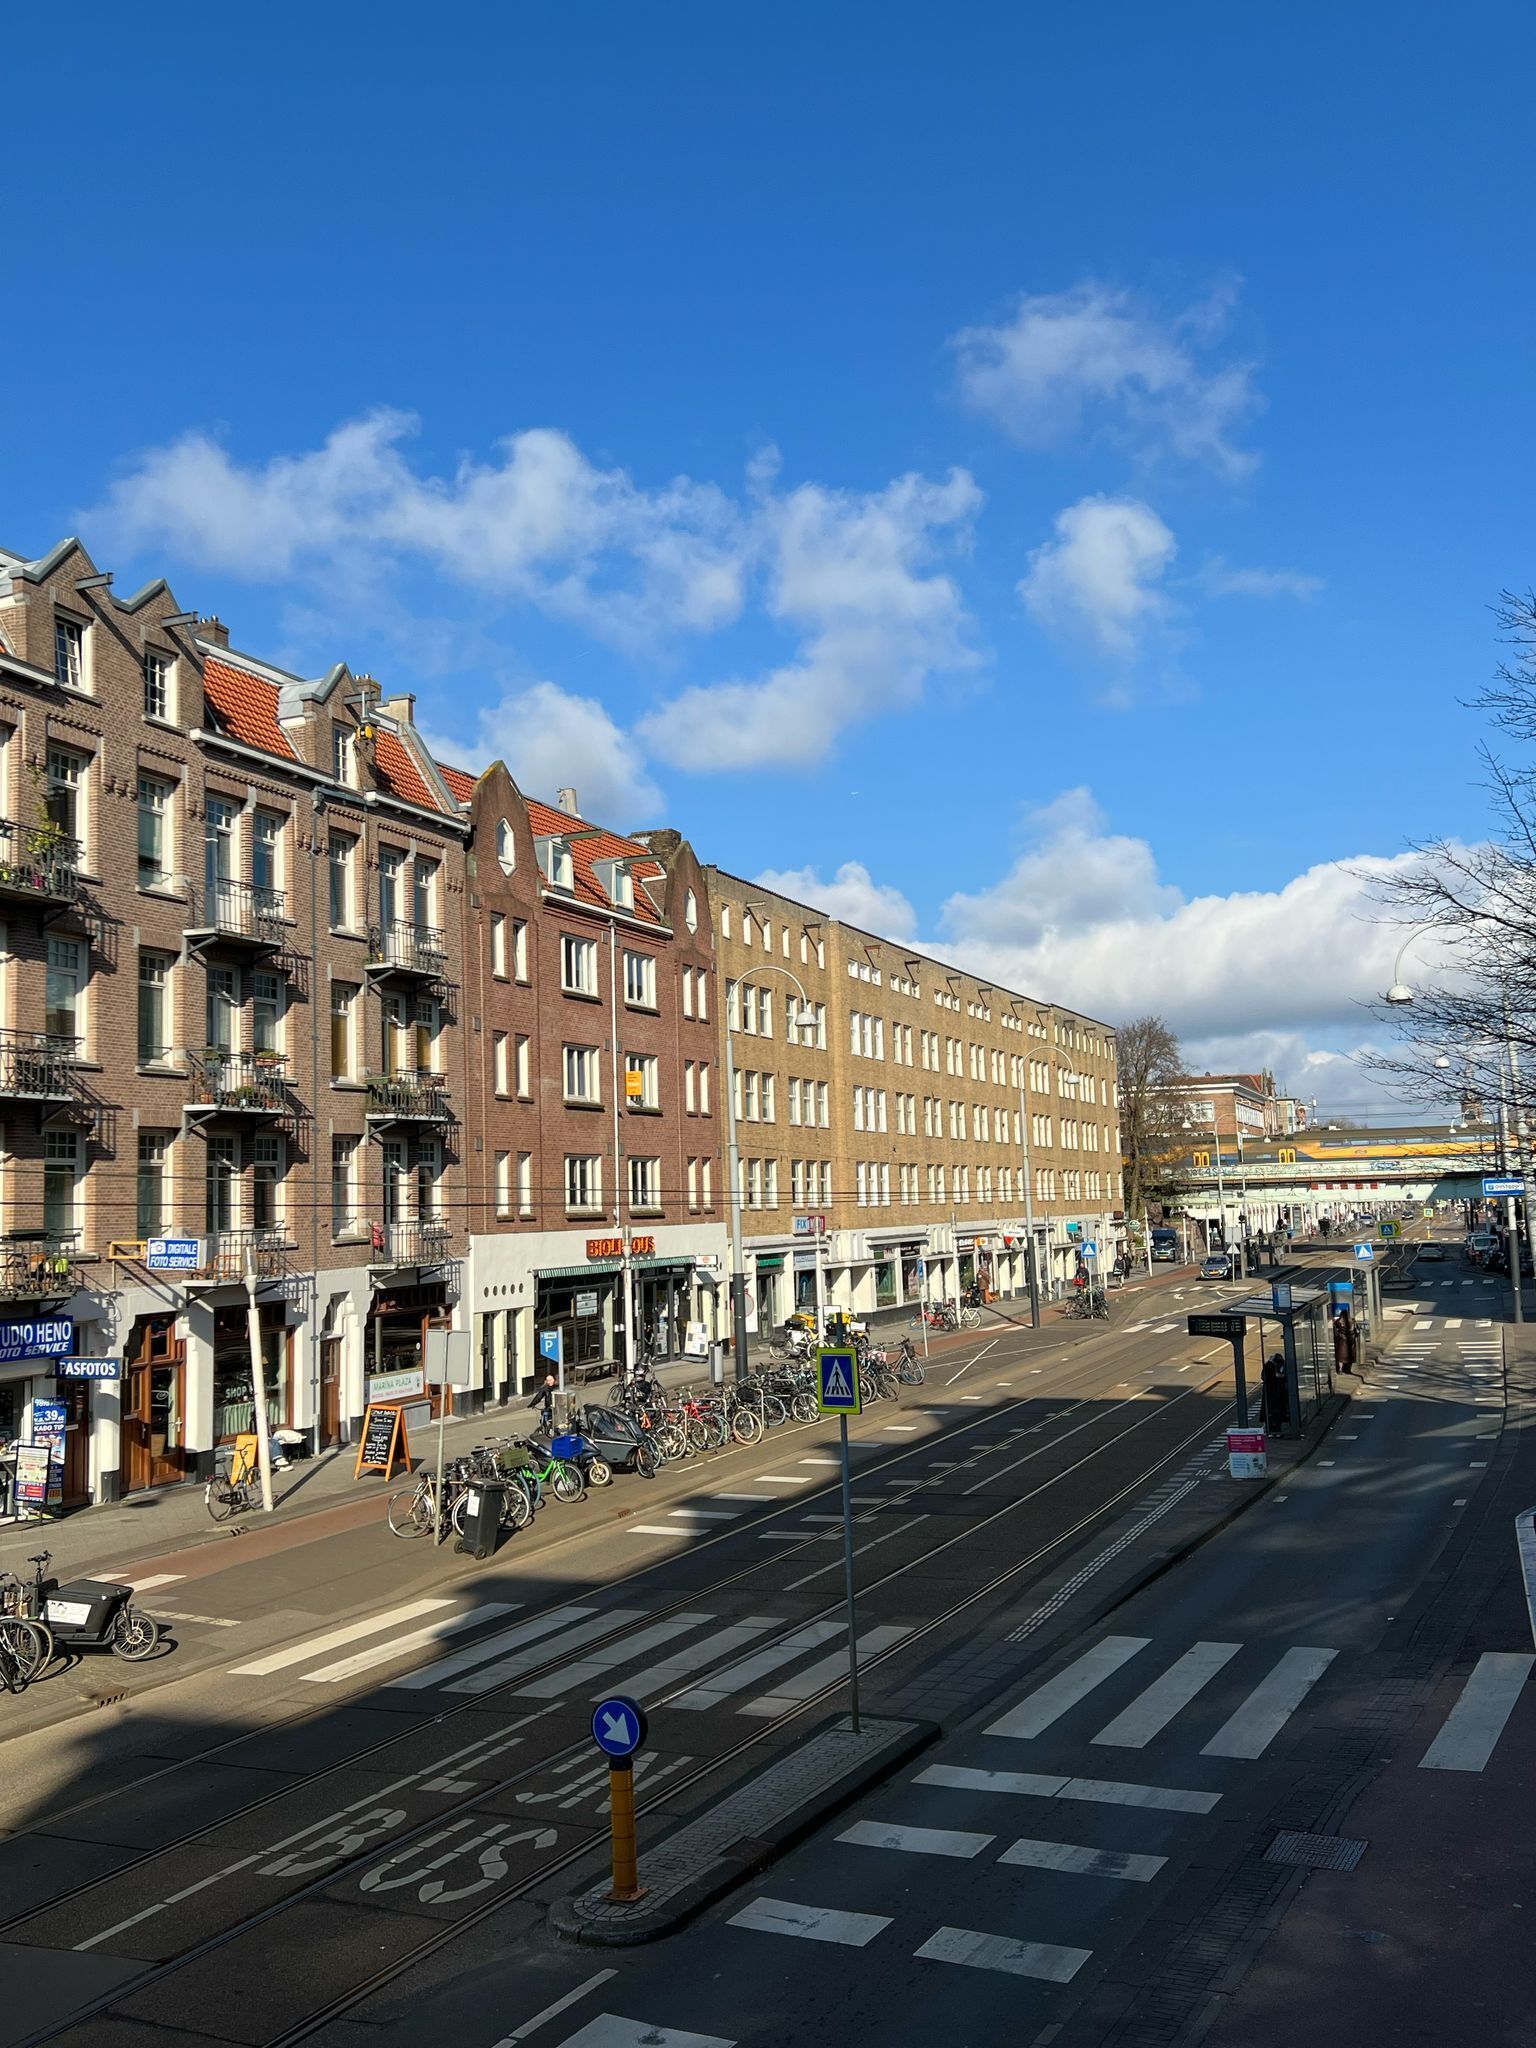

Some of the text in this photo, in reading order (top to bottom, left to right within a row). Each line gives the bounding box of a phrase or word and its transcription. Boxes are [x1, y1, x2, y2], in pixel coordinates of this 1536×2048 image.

[167, 1243, 198, 1255] DIGITALE
[150, 1256, 198, 1267] FOTO SERVICE
[0, 1320, 72, 1348] UDIO HENO
[24, 1341, 69, 1356] SERVICE
[545, 1340, 554, 1353] P
[59, 1362, 116, 1377] PASFOTOS
[373, 1376, 412, 1391] MARINA PLAZA
[225, 1385, 248, 1399] SHOP
[45, 1410, 58, 1421] 39
[255, 1808, 558, 1904] BUS
